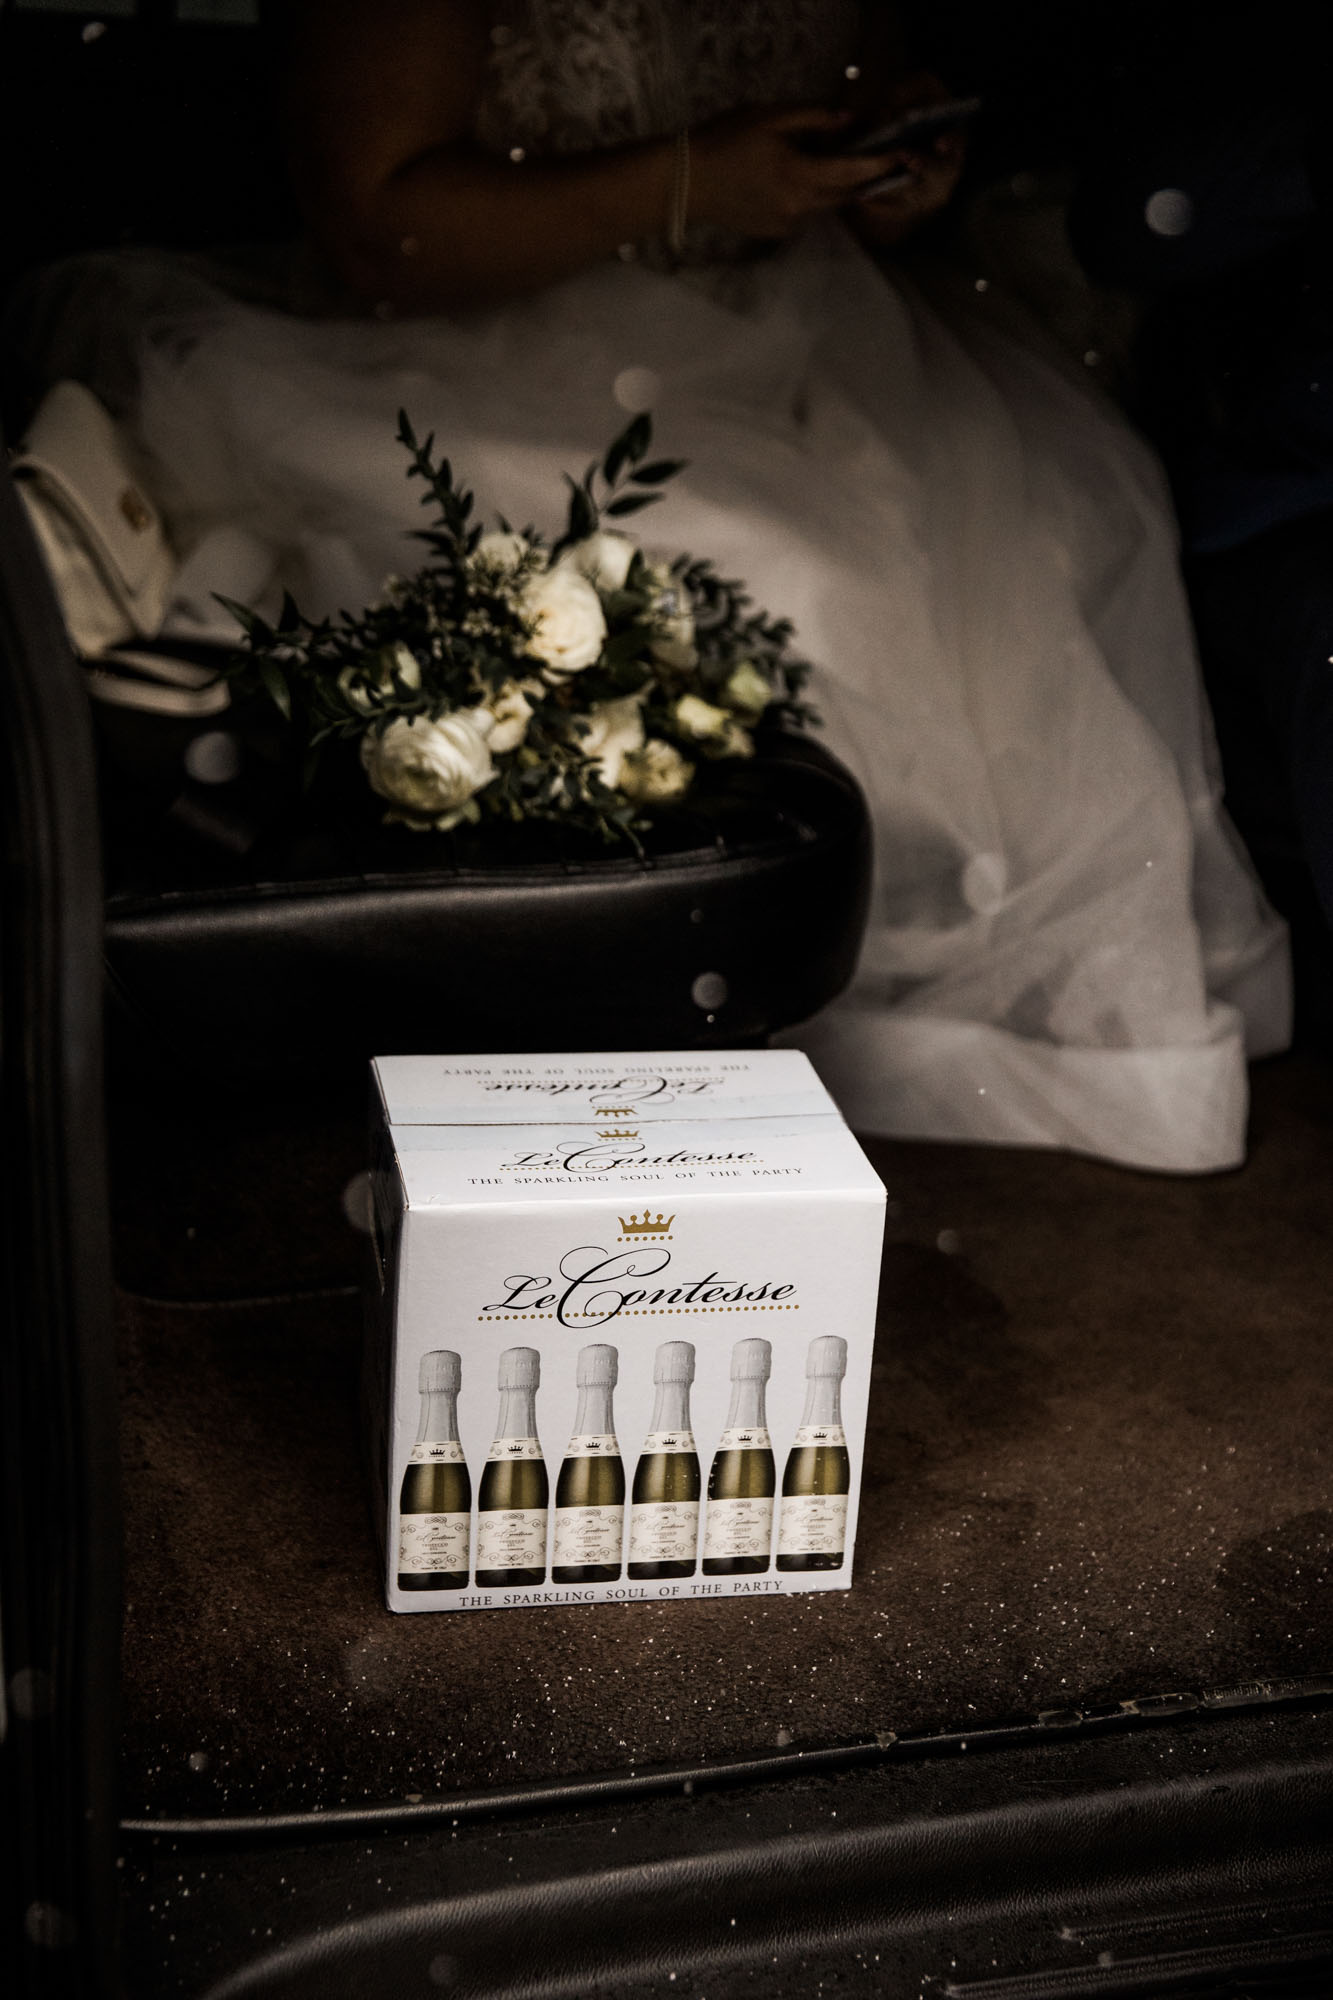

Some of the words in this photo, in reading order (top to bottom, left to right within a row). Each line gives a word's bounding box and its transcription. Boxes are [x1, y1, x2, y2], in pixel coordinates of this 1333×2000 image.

[501, 1151, 560, 1167] Le
[555, 1140, 758, 1174] Contesse
[467, 1177, 503, 1185] THE
[514, 1175, 609, 1185] SPARKLING
[619, 1173, 665, 1182] SOUL
[674, 1171, 697, 1179] OF
[706, 1169, 743, 1178] THE
[752, 1167, 803, 1177] PARTY
[482, 1274, 560, 1312] Le
[556, 1246, 798, 1329] Contesse
[459, 1595, 493, 1608] THE
[503, 1590, 596, 1606] SPARKLING
[605, 1587, 648, 1600] SOUL
[658, 1585, 681, 1597] OF
[690, 1583, 723, 1596] THE
[732, 1580, 784, 1593] PARTY
